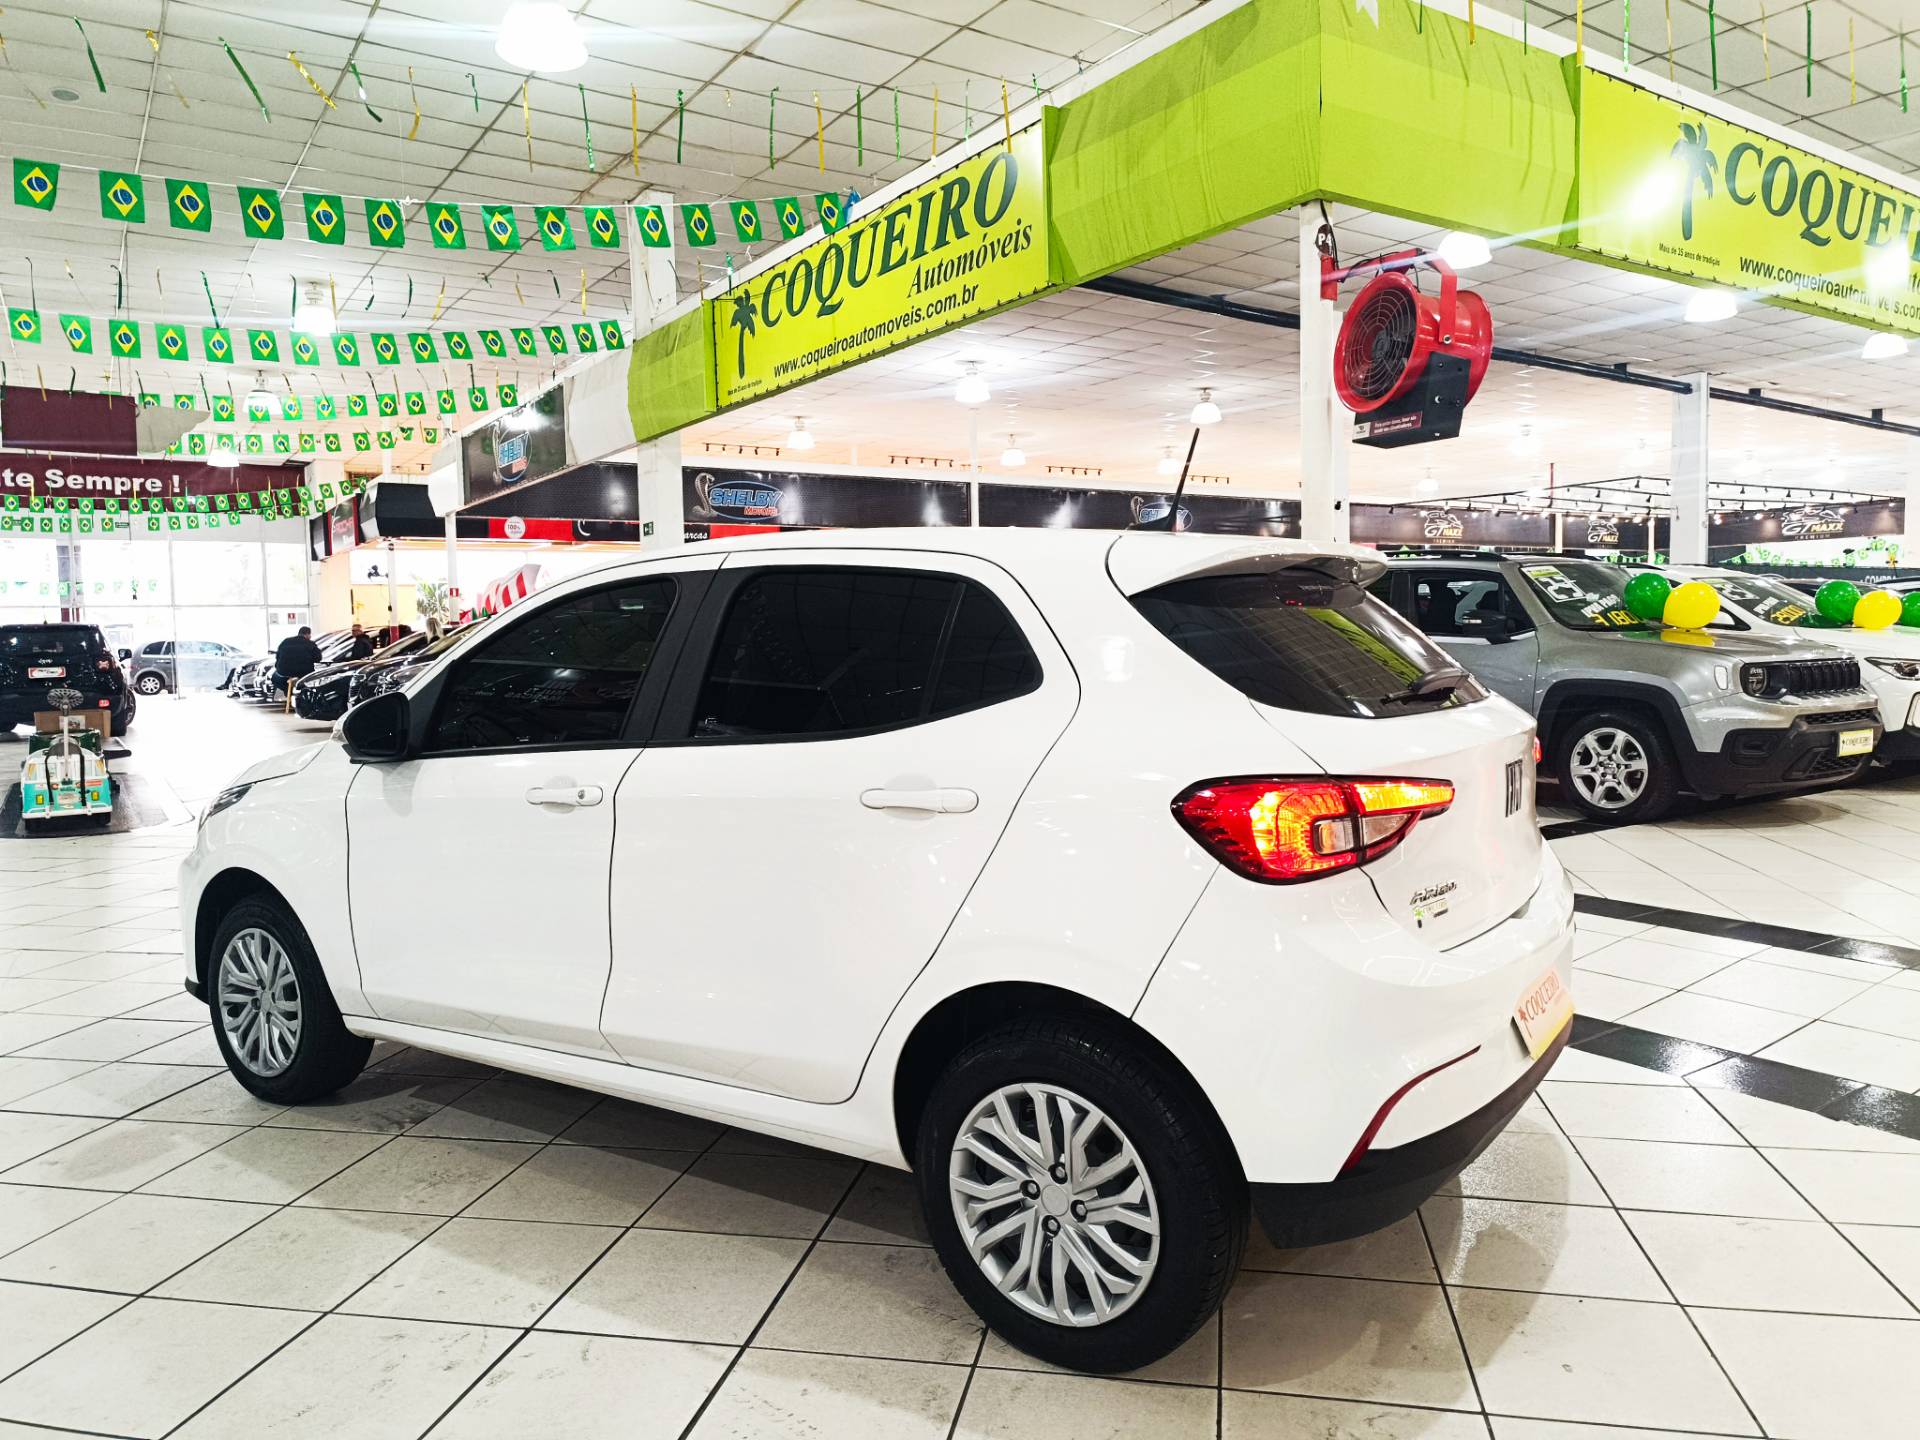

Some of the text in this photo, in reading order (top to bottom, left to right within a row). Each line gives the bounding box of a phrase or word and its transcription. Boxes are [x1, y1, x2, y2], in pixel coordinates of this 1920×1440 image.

[760, 151, 1019, 328] COQUEIRO
[907, 217, 1033, 299] Automóveis
[1739, 256, 1920, 322] www.coqueiroautomveis.co
[773, 283, 979, 379] www.coqueiroautomoveis.com.br
[0, 469, 35, 488] te
[45, 469, 163, 496] Sempre
[709, 488, 783, 507] SHELBY
